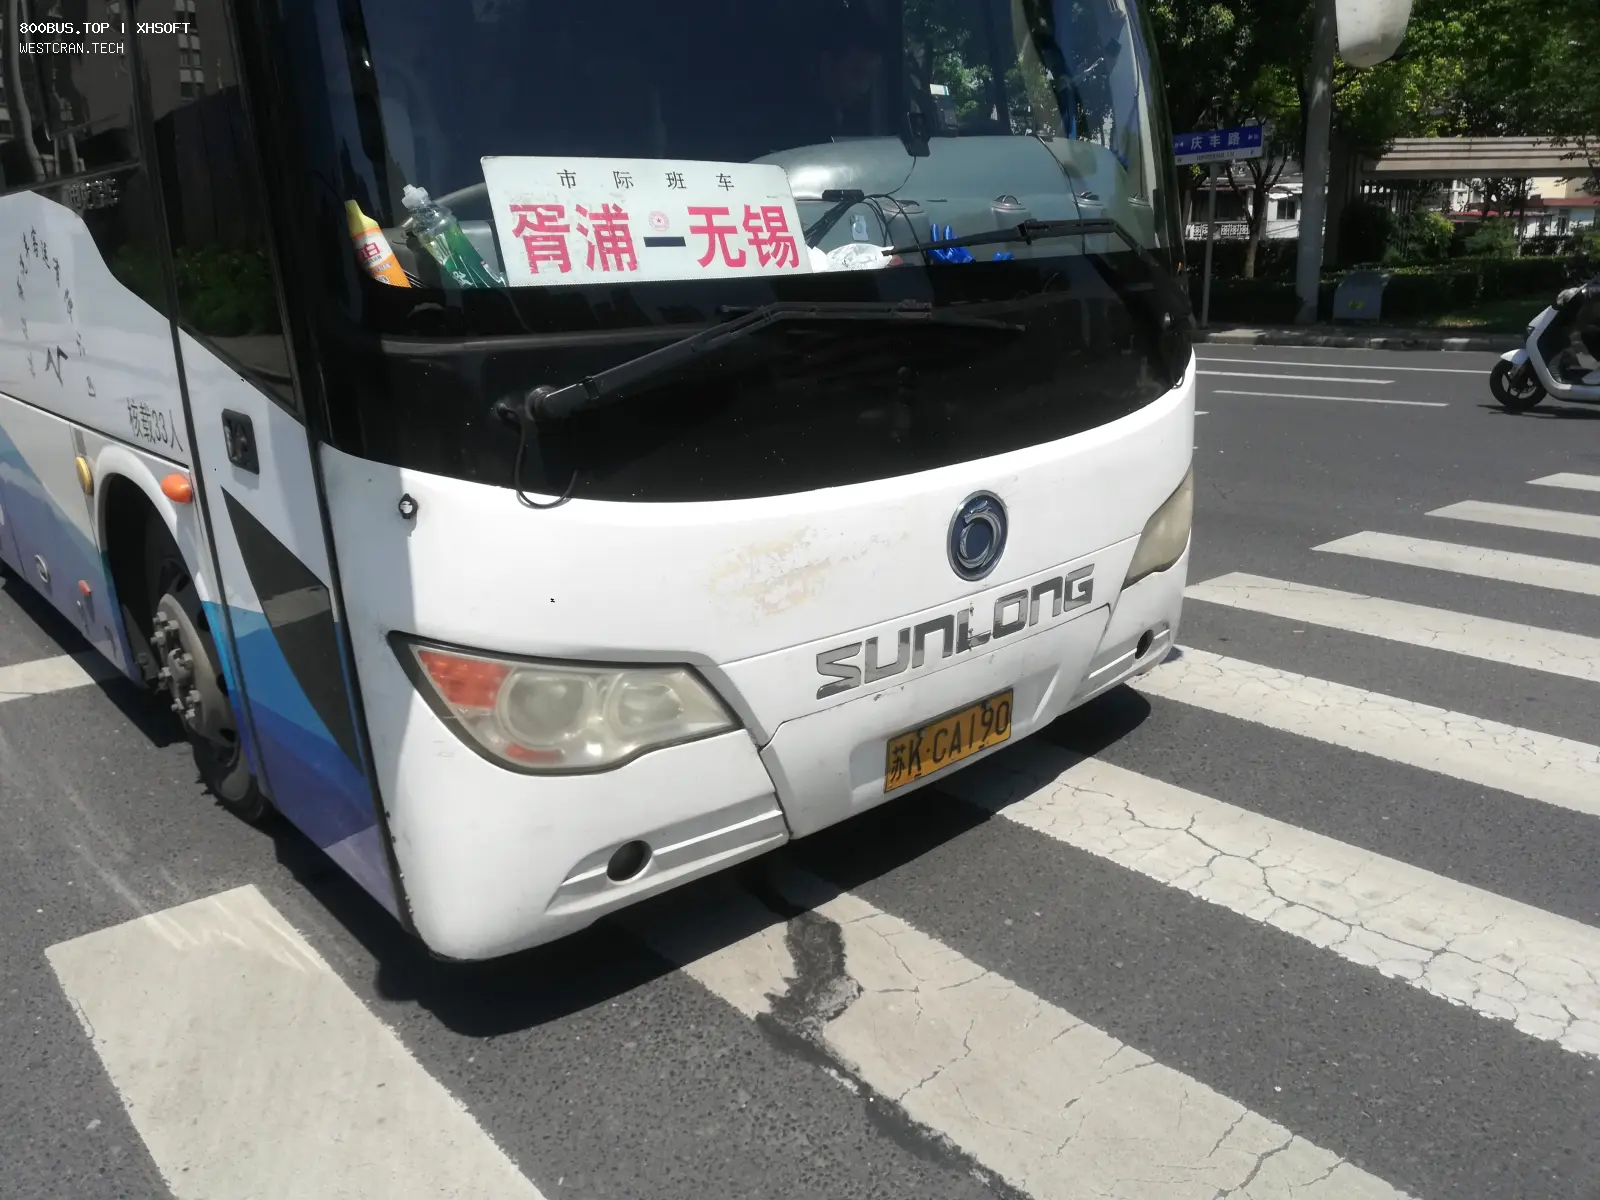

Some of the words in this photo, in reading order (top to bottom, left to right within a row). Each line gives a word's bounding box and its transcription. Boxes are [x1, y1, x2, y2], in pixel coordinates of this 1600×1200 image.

[1190, 132, 1241, 150] 庆丰路
[556, 169, 735, 192] 市际班车
[127, 398, 183, 452] 核载33人
[815, 563, 1095, 700] SUNLONG
